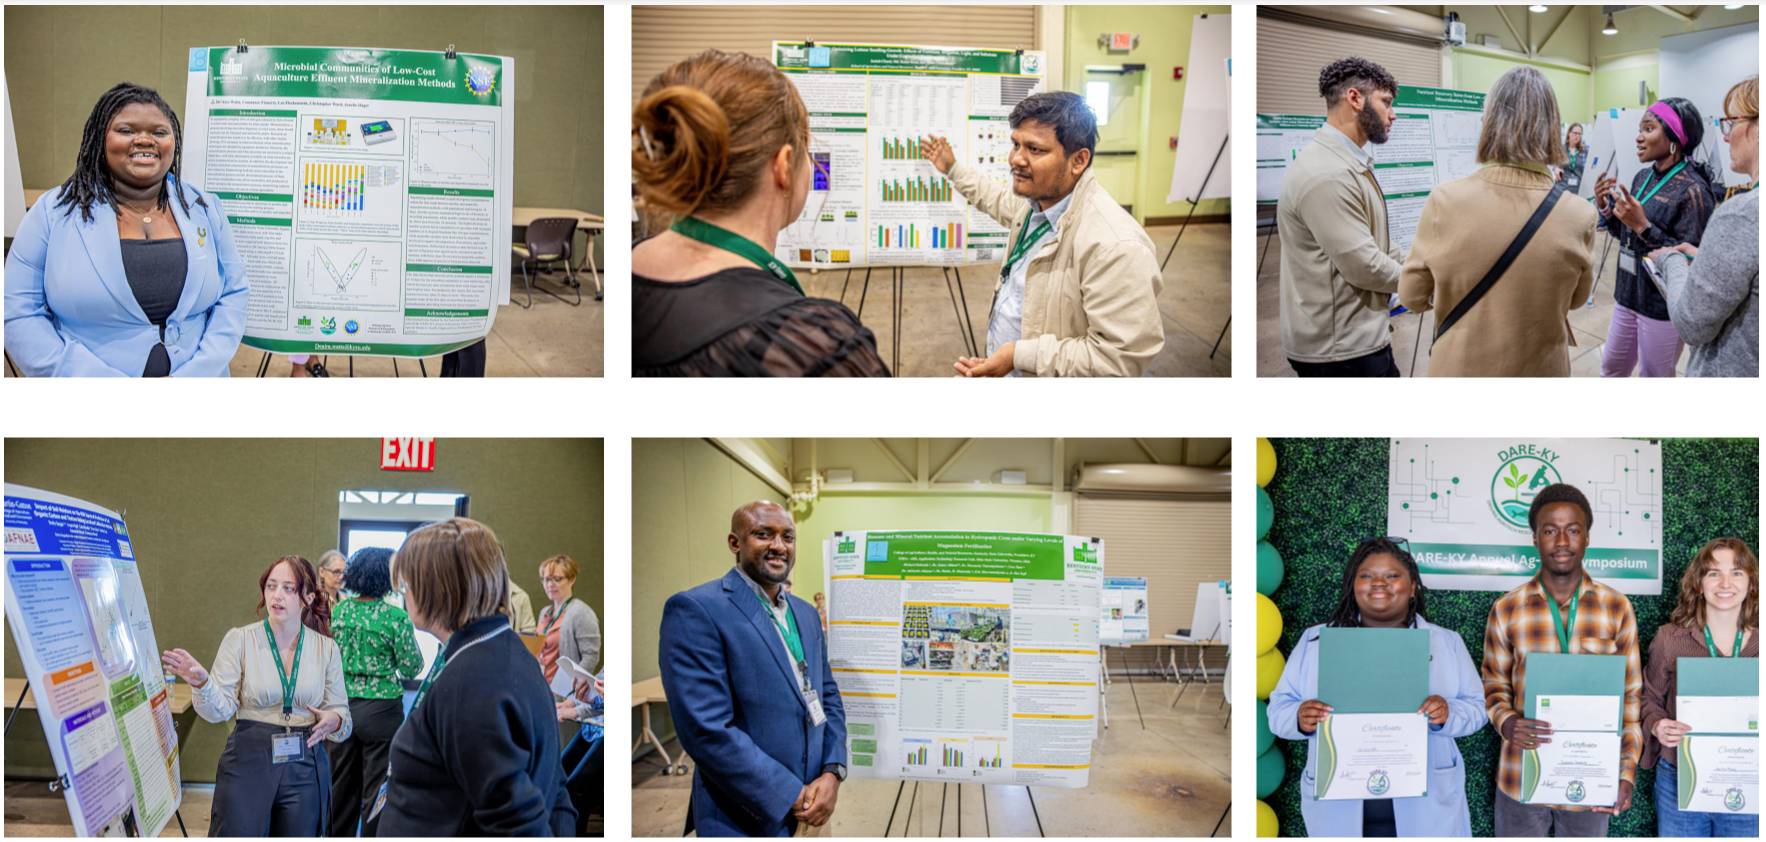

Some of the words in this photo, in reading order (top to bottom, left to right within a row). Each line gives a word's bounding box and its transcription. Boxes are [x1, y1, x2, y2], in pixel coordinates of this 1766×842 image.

[274, 62, 318, 71] Microbial
[320, 63, 379, 74] Communities
[381, 65, 391, 73] of
[393, 65, 436, 76] Low-Cost
[254, 74, 309, 83] Aquaculture
[311, 74, 347, 83] Effluent
[349, 75, 415, 87] Mineralization
[417, 77, 456, 88] Methods
[383, 437, 433, 468] EXIT
[1497, 444, 1560, 462] DARE-KY
[1470, 553, 1516, 567] Annual
[1583, 557, 1648, 571] ymposium
